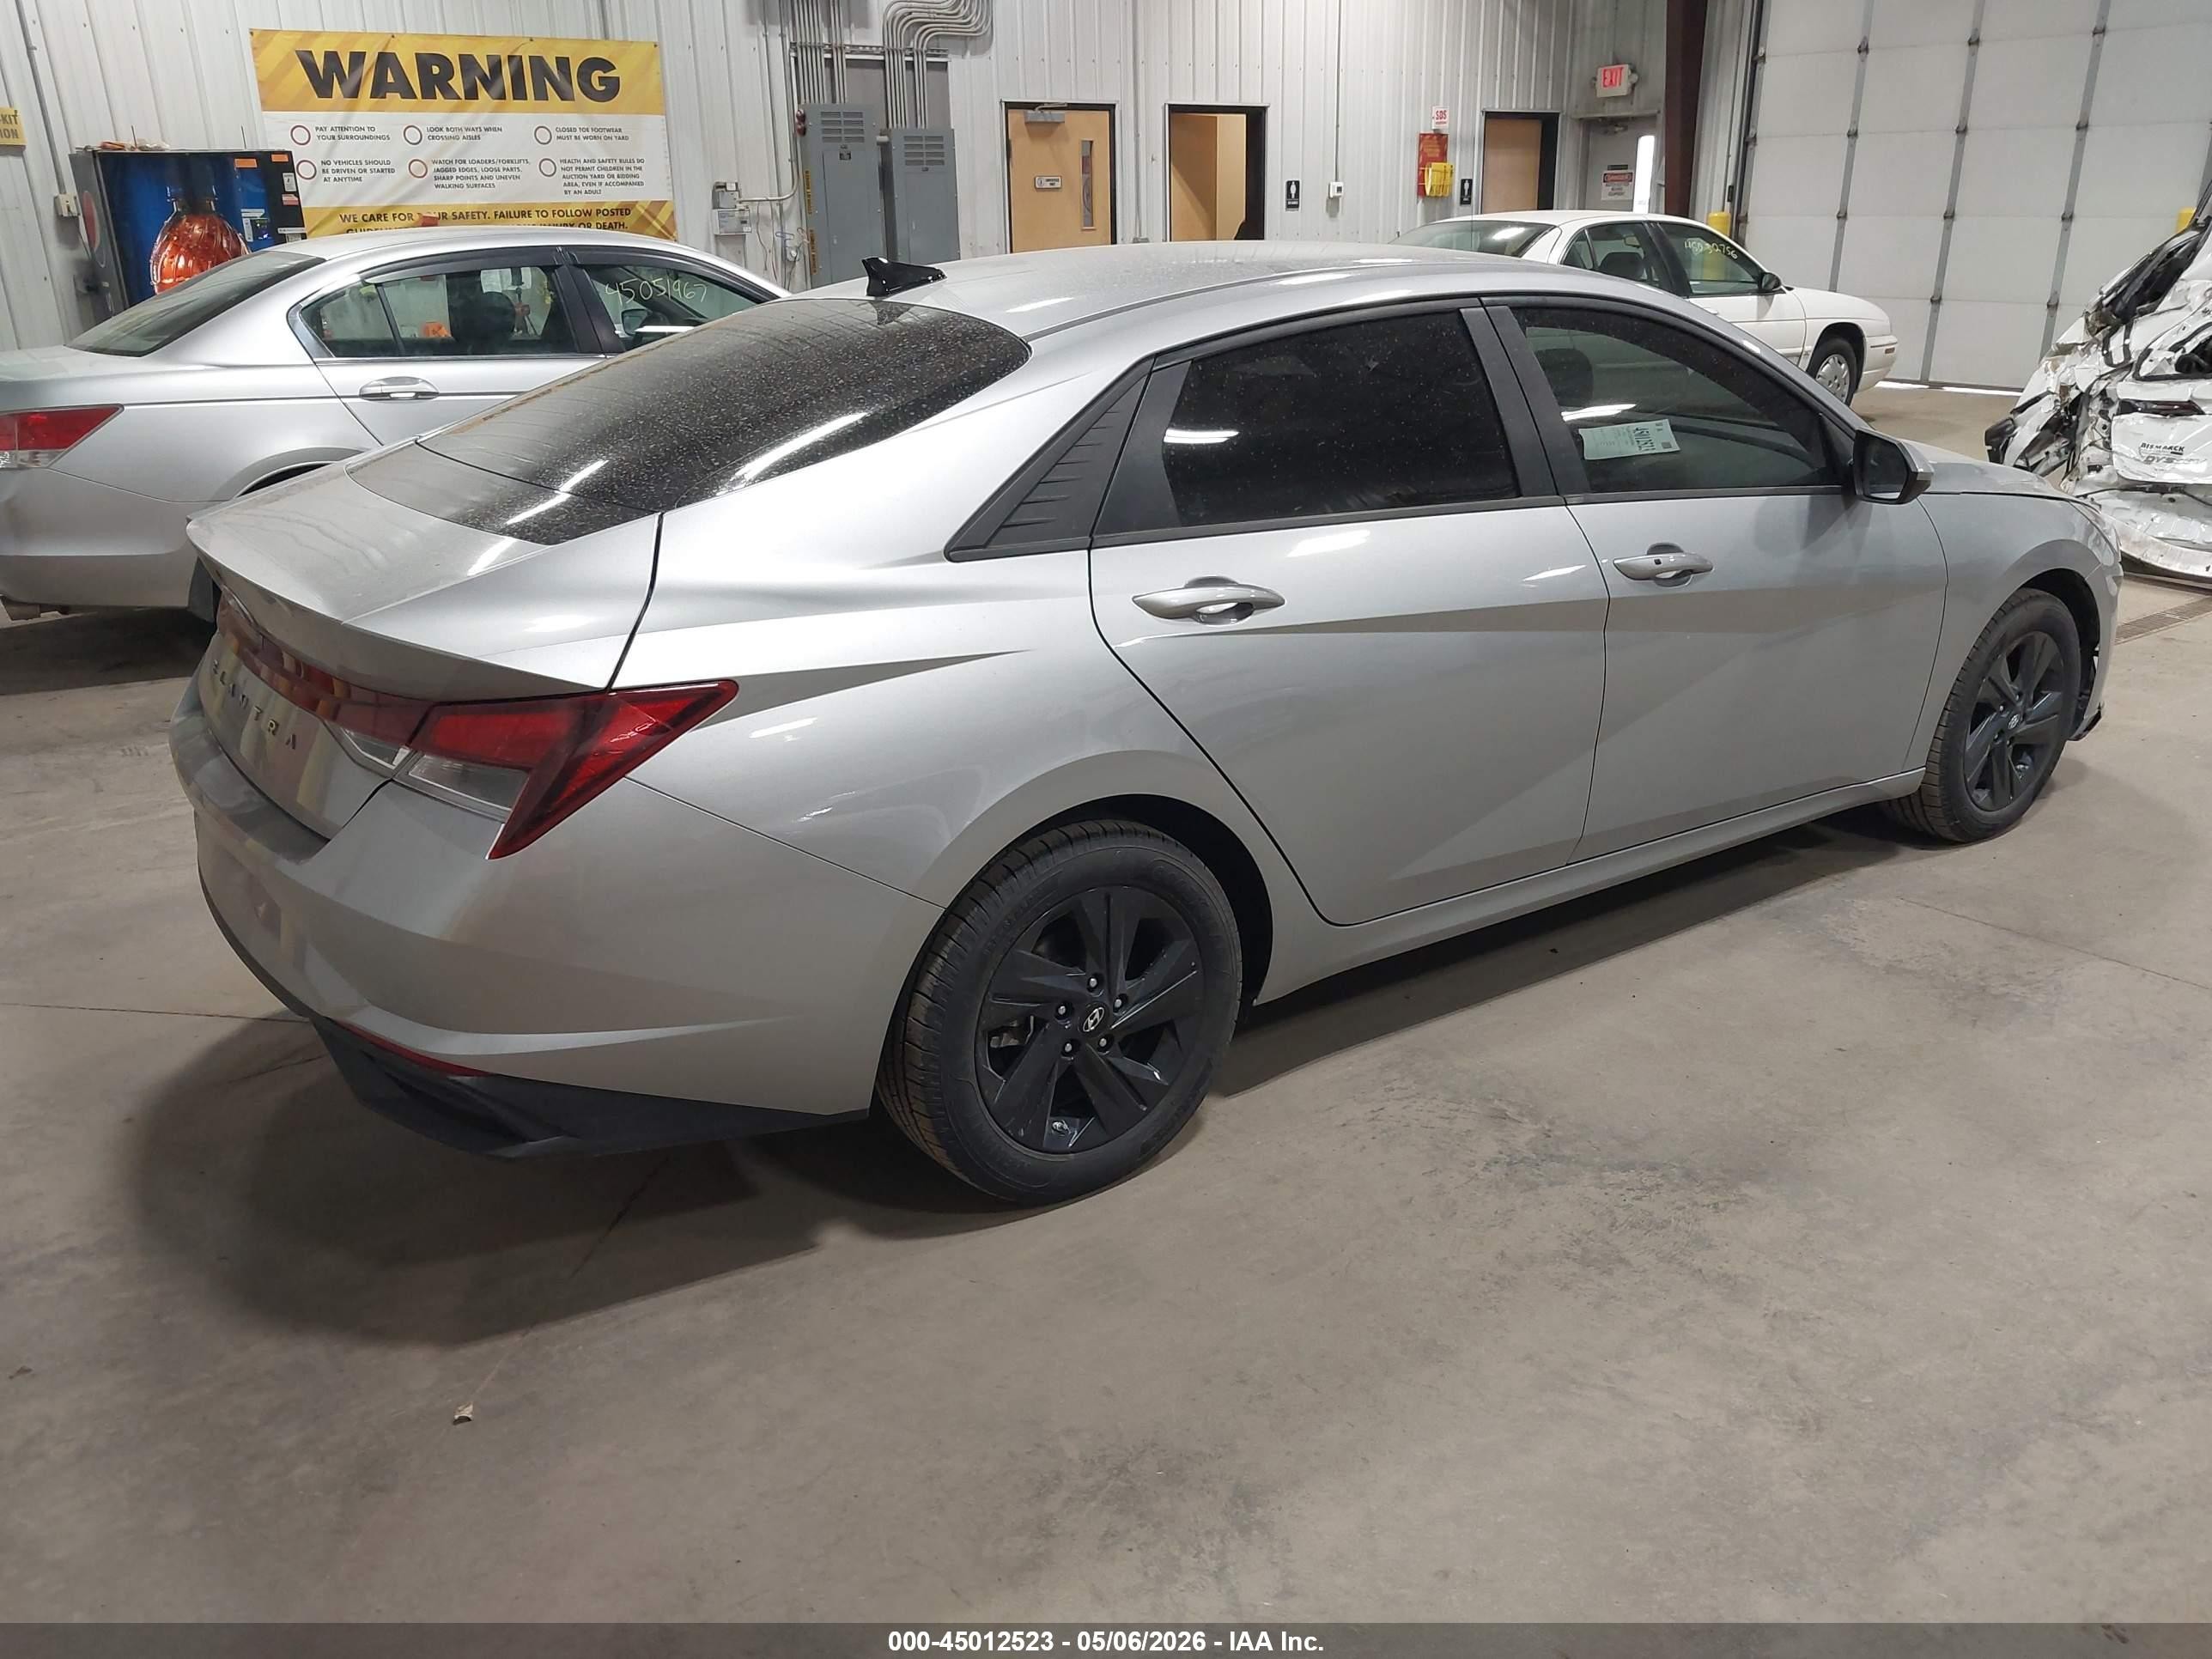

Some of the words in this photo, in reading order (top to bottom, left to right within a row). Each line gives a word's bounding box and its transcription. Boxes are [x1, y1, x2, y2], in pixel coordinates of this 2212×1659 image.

[295, 50, 620, 102] WARNING
[1602, 67, 1623, 87] EXIT
[1436, 110, 1447, 120] SDS
[340, 214, 358, 222] WE
[362, 213, 388, 222] CARE
[392, 212, 414, 222] FOR
[453, 210, 490, 220] SAFETY.
[494, 210, 532, 219] FAILURE
[536, 210, 548, 218] TO
[552, 209, 593, 218] FOLLOW
[596, 208, 631, 216] POSTED
[596, 222, 629, 230] DEATH.
[605, 277, 707, 306] 45051967
[2140, 442, 2185, 453] BISMARCK
[212, 659, 297, 750] ELANTRA
